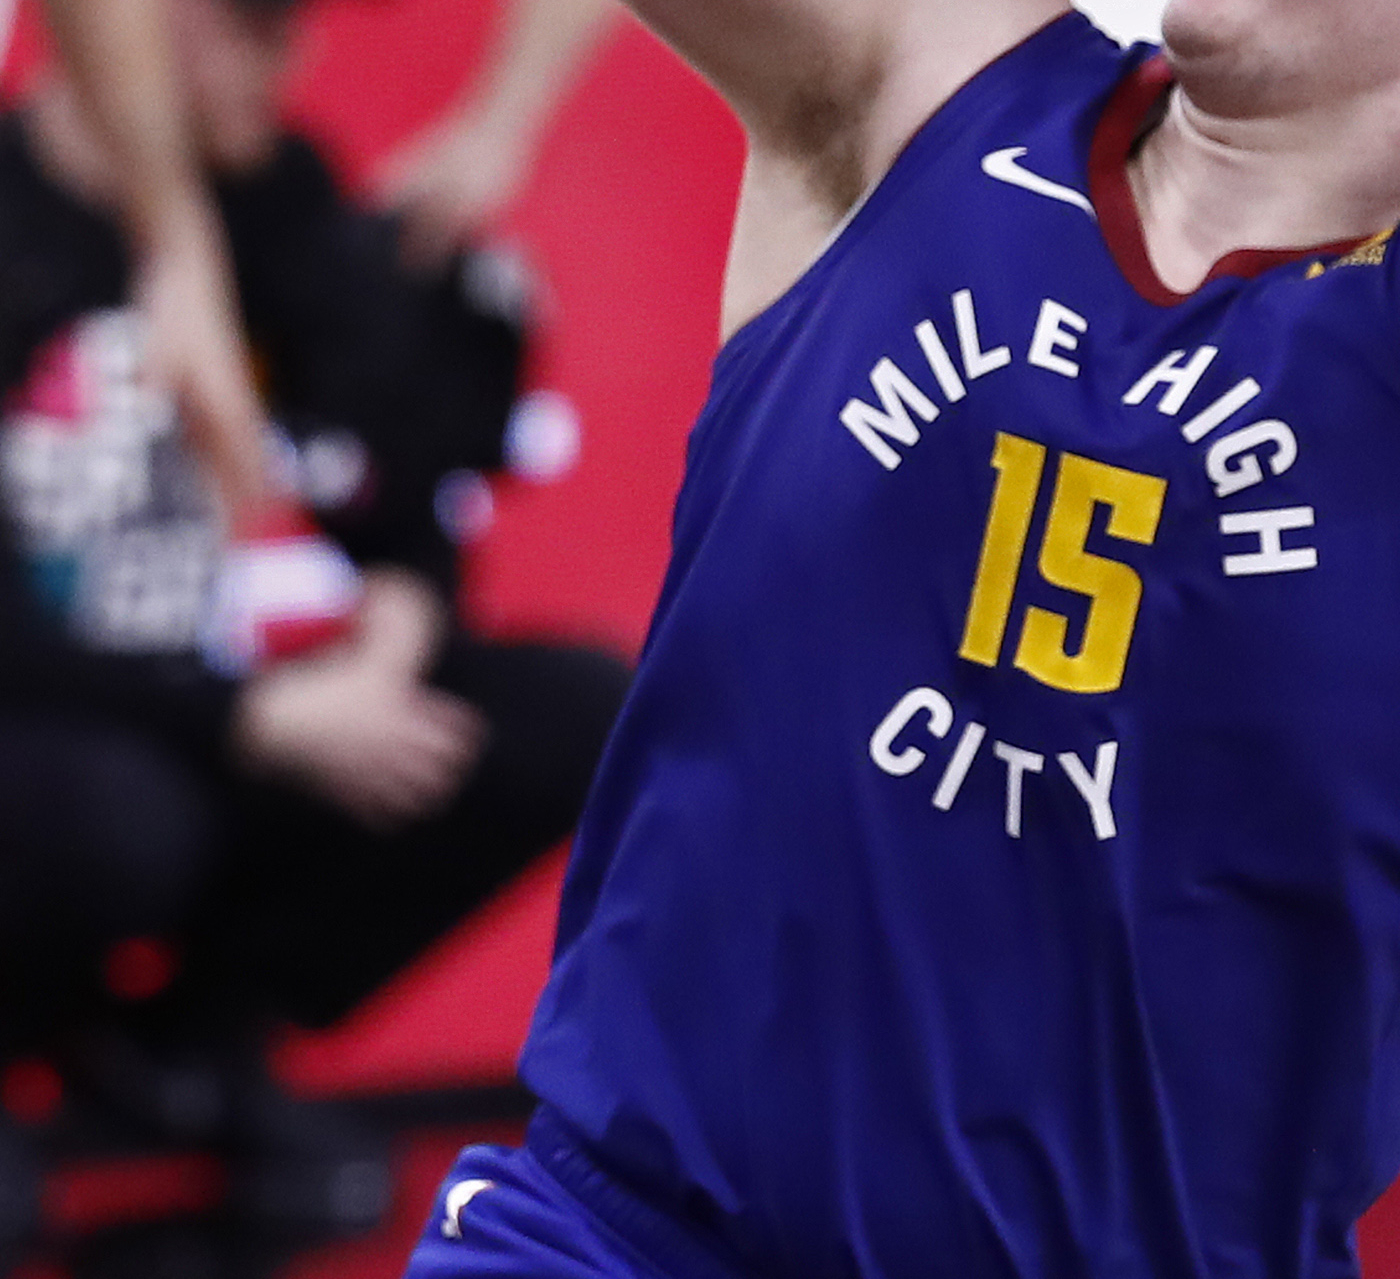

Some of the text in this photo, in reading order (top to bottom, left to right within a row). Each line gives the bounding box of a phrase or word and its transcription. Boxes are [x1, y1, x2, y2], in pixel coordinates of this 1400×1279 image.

[840, 288, 1319, 577] MILE HIGH
[959, 430, 1168, 694] 15
[869, 687, 1118, 840] CITY
